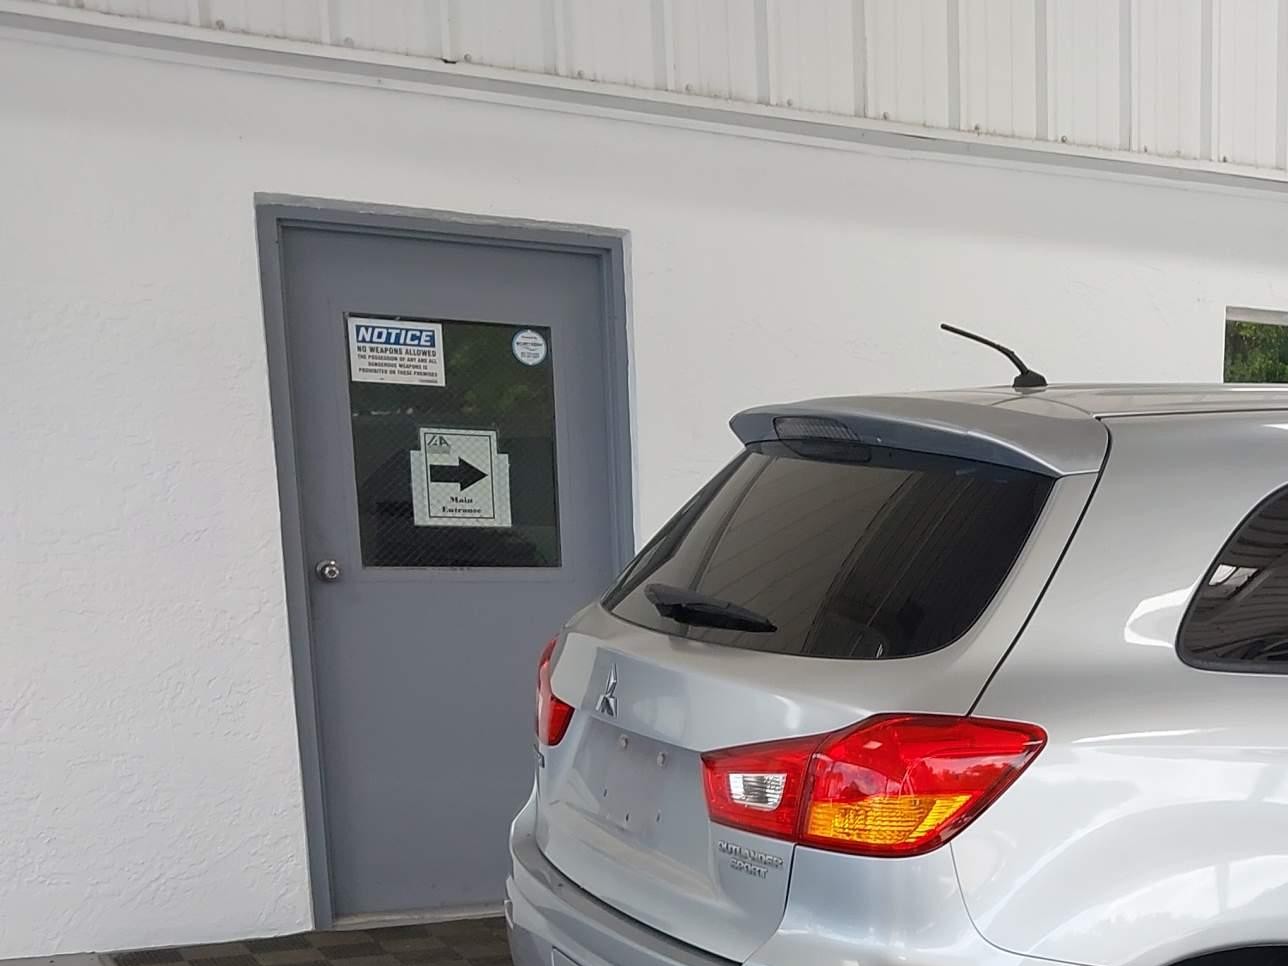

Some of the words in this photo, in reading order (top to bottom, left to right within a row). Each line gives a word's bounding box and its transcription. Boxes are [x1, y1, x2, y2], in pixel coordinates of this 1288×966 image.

[358, 326, 433, 346] NOTICE
[357, 345, 367, 353] NO
[369, 346, 403, 355] WEAPONS
[405, 348, 437, 357] ALLOWED
[368, 354, 398, 362] POSSESSION
[358, 367, 388, 375] PROHIBITED
[413, 370, 438, 378] PREMISES
[450, 496, 473, 504] Main
[442, 506, 482, 514] Entrance
[718, 840, 784, 868] OUTLANDER
[729, 858, 769, 879] SPORT
